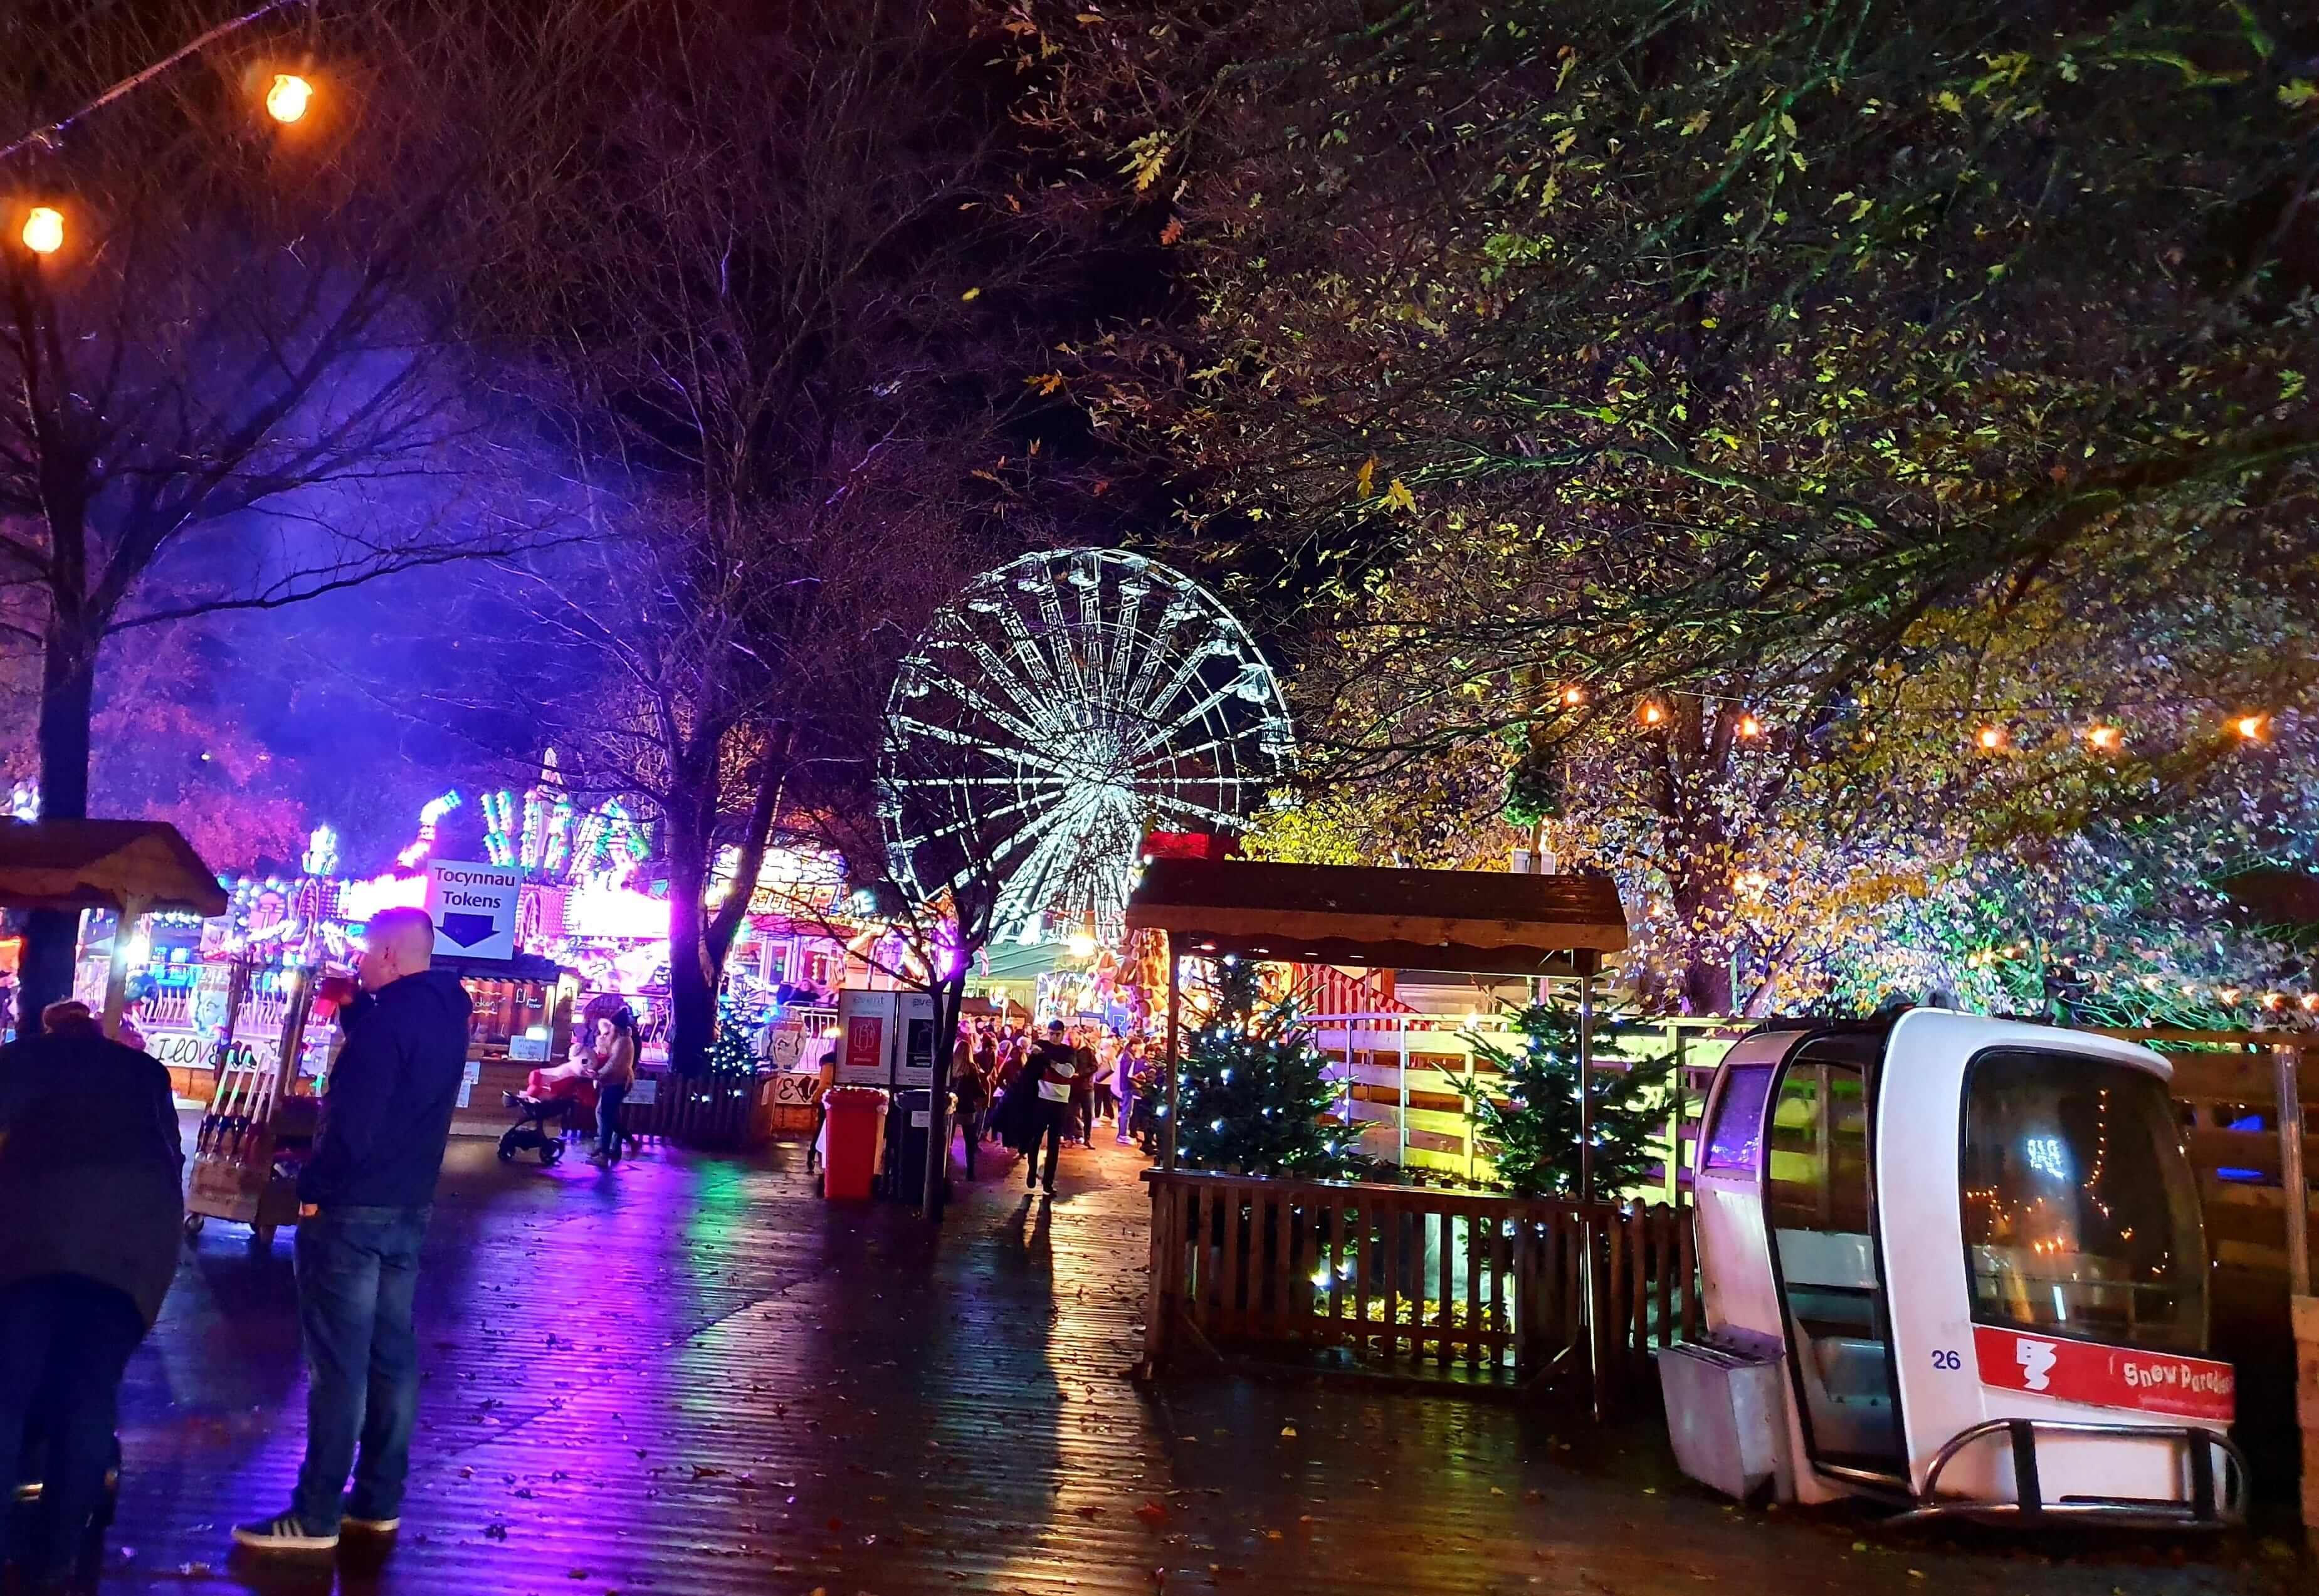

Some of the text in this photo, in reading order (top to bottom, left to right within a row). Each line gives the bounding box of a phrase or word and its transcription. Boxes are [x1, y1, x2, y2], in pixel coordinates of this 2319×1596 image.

[434, 867, 515, 886] Tocynnau
[442, 891, 502, 908] Tokens
[1931, 1350, 1961, 1370] 26
[2123, 1362, 2177, 1387] Snow
